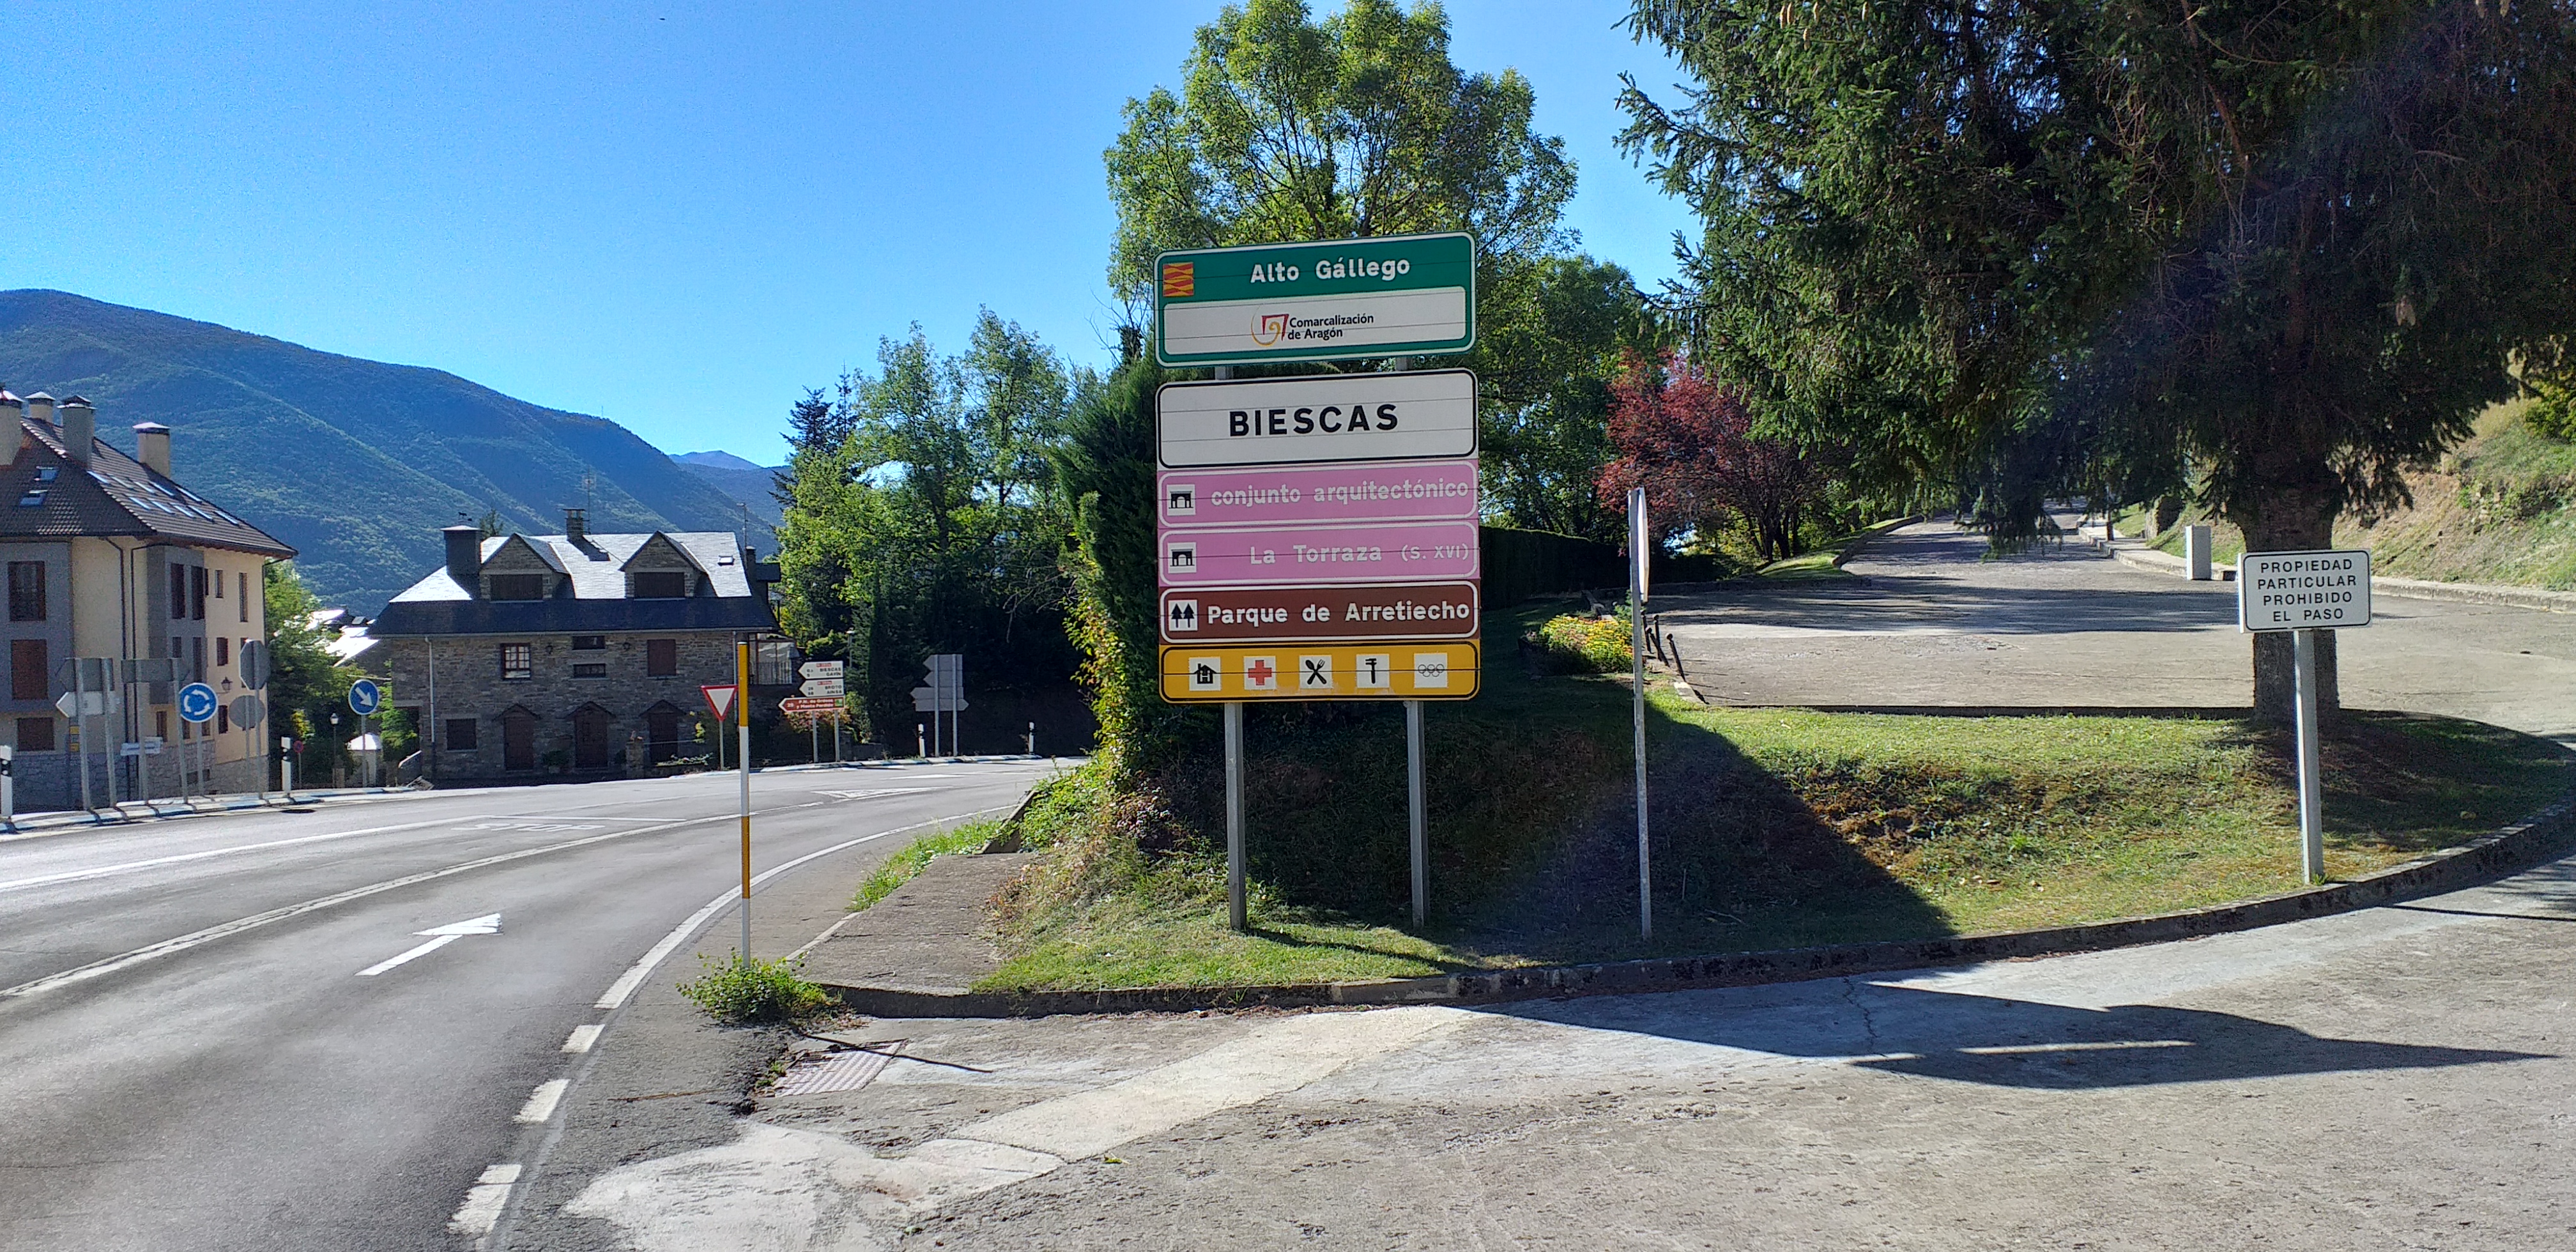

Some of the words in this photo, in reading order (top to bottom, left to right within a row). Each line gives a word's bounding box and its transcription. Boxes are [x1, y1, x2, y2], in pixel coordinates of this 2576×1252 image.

[1250, 261, 1300, 283] Alto
[1315, 256, 1410, 280] Gállego
[1289, 312, 1374, 328] Comarcalización
[1287, 330, 1302, 340] de
[1304, 326, 1343, 340] Aragón
[1229, 404, 1398, 437] BIESCAS
[1211, 484, 1301, 508] conjunto
[1314, 478, 1469, 504] arquitectónico
[1250, 546, 1276, 565] La
[1292, 544, 1382, 563] Torraza
[1401, 544, 1427, 561] (S.
[1434, 543, 1469, 560] XVI)
[2260, 559, 2352, 573] PROPIEDAD
[2258, 576, 2356, 590] PARTICULAR
[2263, 592, 2352, 606] PROHIBIDO
[1207, 604, 1288, 627] Parque
[1301, 604, 1331, 623] de
[1345, 600, 1470, 622] Arretiecho
[2273, 611, 2291, 622] EL
[2304, 608, 2343, 620] PASO
